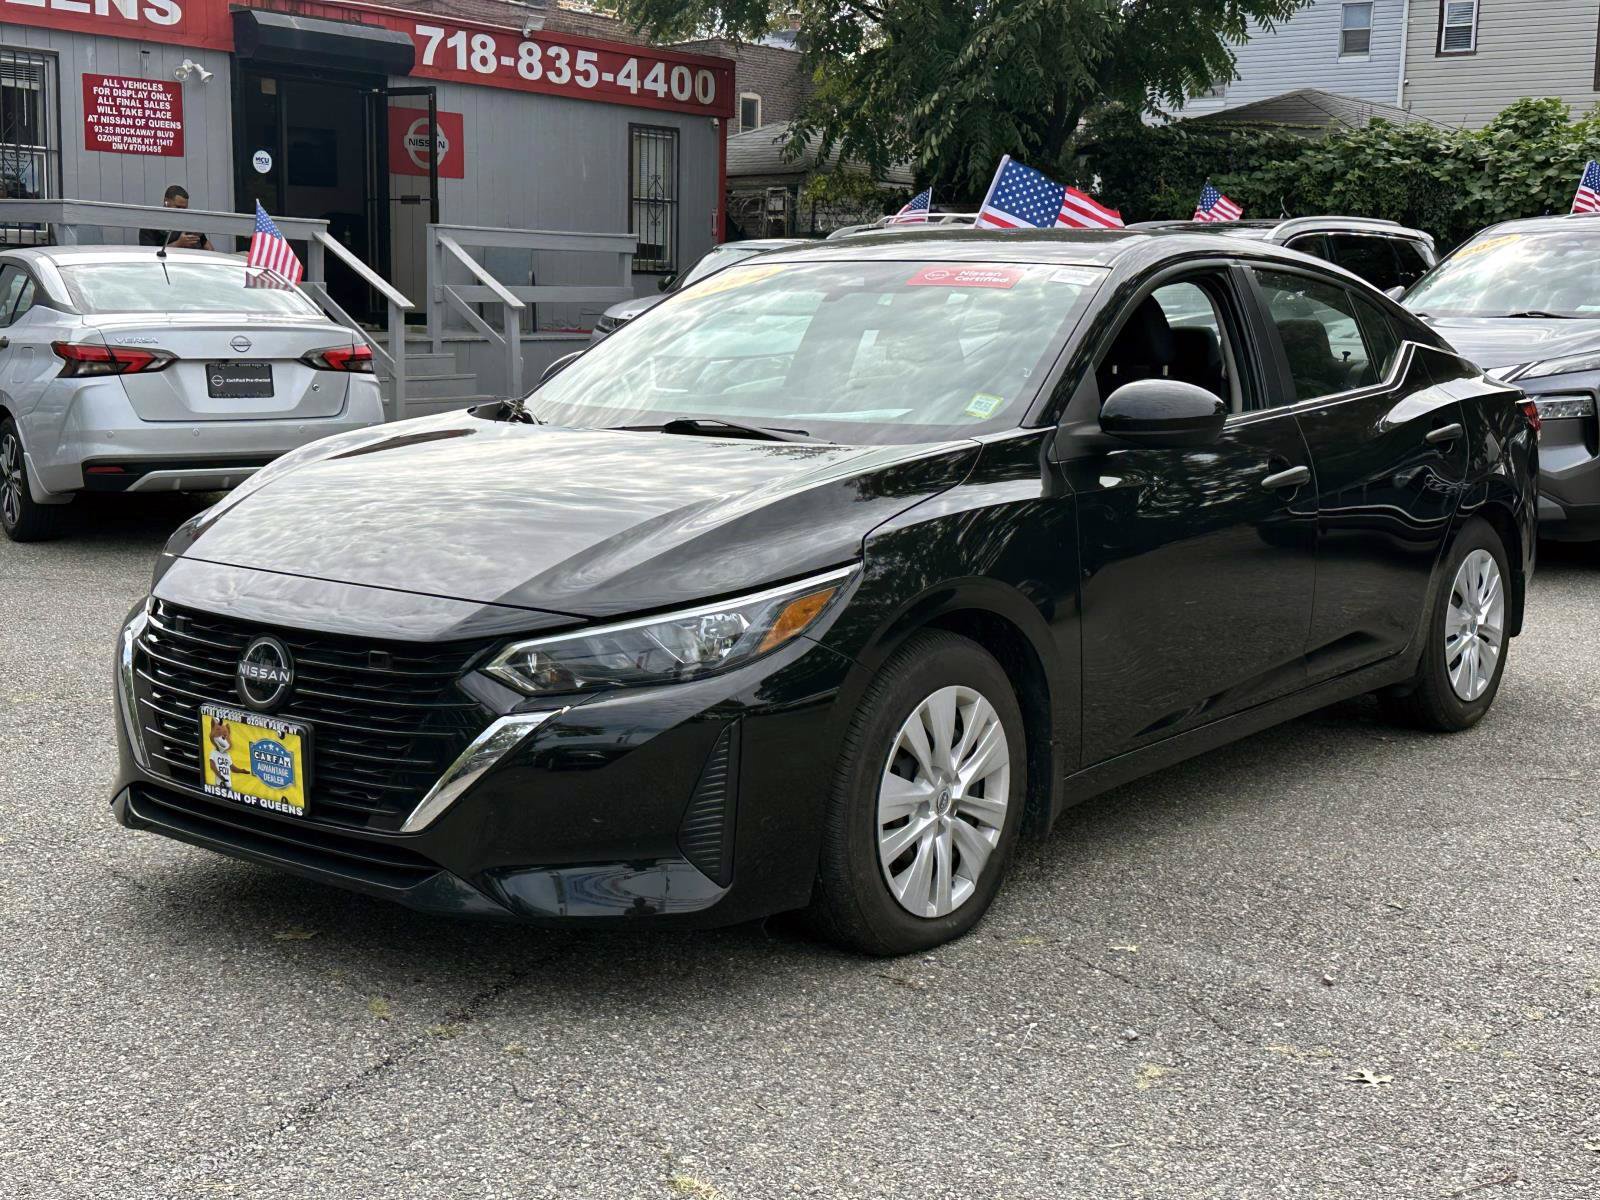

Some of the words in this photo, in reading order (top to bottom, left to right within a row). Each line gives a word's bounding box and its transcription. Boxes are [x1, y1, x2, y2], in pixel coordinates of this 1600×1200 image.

[415, 24, 716, 105] 718-835-4400
[103, 79, 120, 87] ALL
[122, 80, 163, 91] VEHICLES
[93, 86, 110, 95] FOR
[113, 88, 148, 99] DISPLAY
[151, 93, 173, 101] ONLY.
[97, 96, 114, 105] ALL
[116, 98, 141, 107] FINAL
[144, 100, 171, 110] SALES
[97, 105, 118, 115] WILL
[121, 107, 143, 117] TAKE
[145, 110, 172, 119] PLACE
[87, 114, 98, 122] AT
[101, 115, 133, 126] NISSAN
[148, 120, 181, 129] QUEENS
[115, 126, 155, 137] ROCKAWAY
[156, 130, 174, 138] BLVD
[97, 134, 121, 143] OZONE
[123, 136, 142, 144] PARK
[156, 139, 173, 147] 11417
[112, 142, 128, 150] DMV
[408, 138, 445, 149] NISSN
[954, 275, 1009, 283] Certified
[239, 663, 290, 682] NISSAN
[254, 751, 291, 768] CARFAX
[263, 773, 285, 785] DEALER
[204, 784, 241, 801] NISSAN
[243, 796, 257, 805] OF
[260, 799, 304, 817] QUEENS
